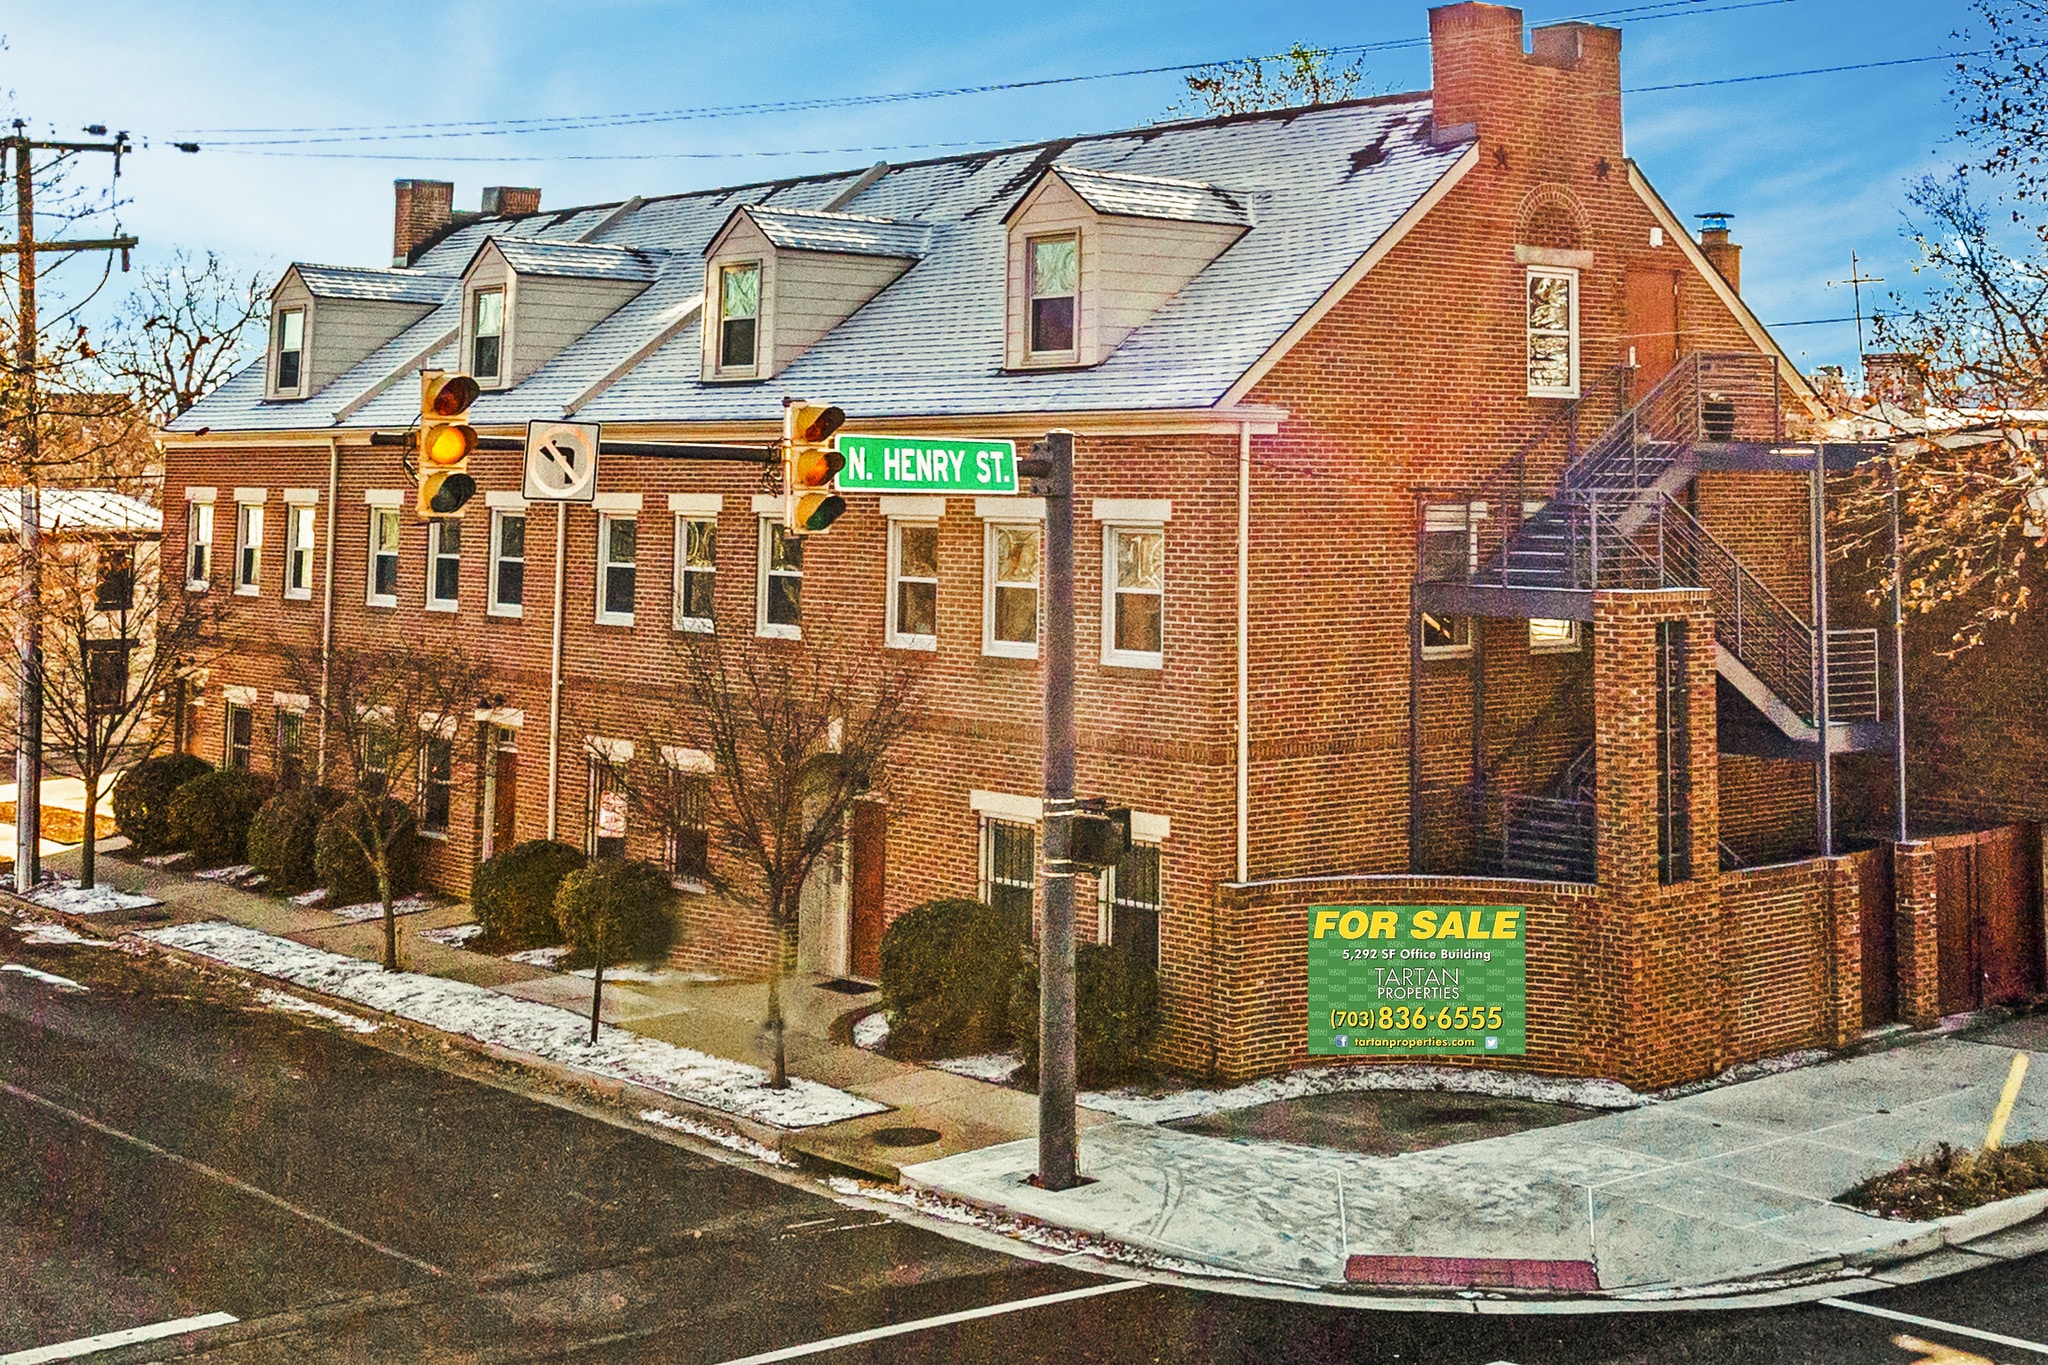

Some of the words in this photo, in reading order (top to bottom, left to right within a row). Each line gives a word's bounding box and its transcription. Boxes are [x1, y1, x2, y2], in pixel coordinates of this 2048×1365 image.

[848, 446, 873, 481] N.
[884, 447, 966, 483] HENRY
[976, 450, 1010, 484] ST.
[1313, 910, 1399, 940] FOR
[1410, 910, 1520, 940] SALE
[1342, 949, 1378, 961] 5,292
[1381, 949, 1396, 959] SF
[1400, 949, 1436, 960] Office
[1441, 949, 1491, 961] Building
[1375, 967, 1459, 986] TARTAN
[1377, 987, 1460, 1000] PROPERTIES
[1330, 1009, 1375, 1030] (703)
[1354, 1037, 1475, 1049] tartanproperties.com
